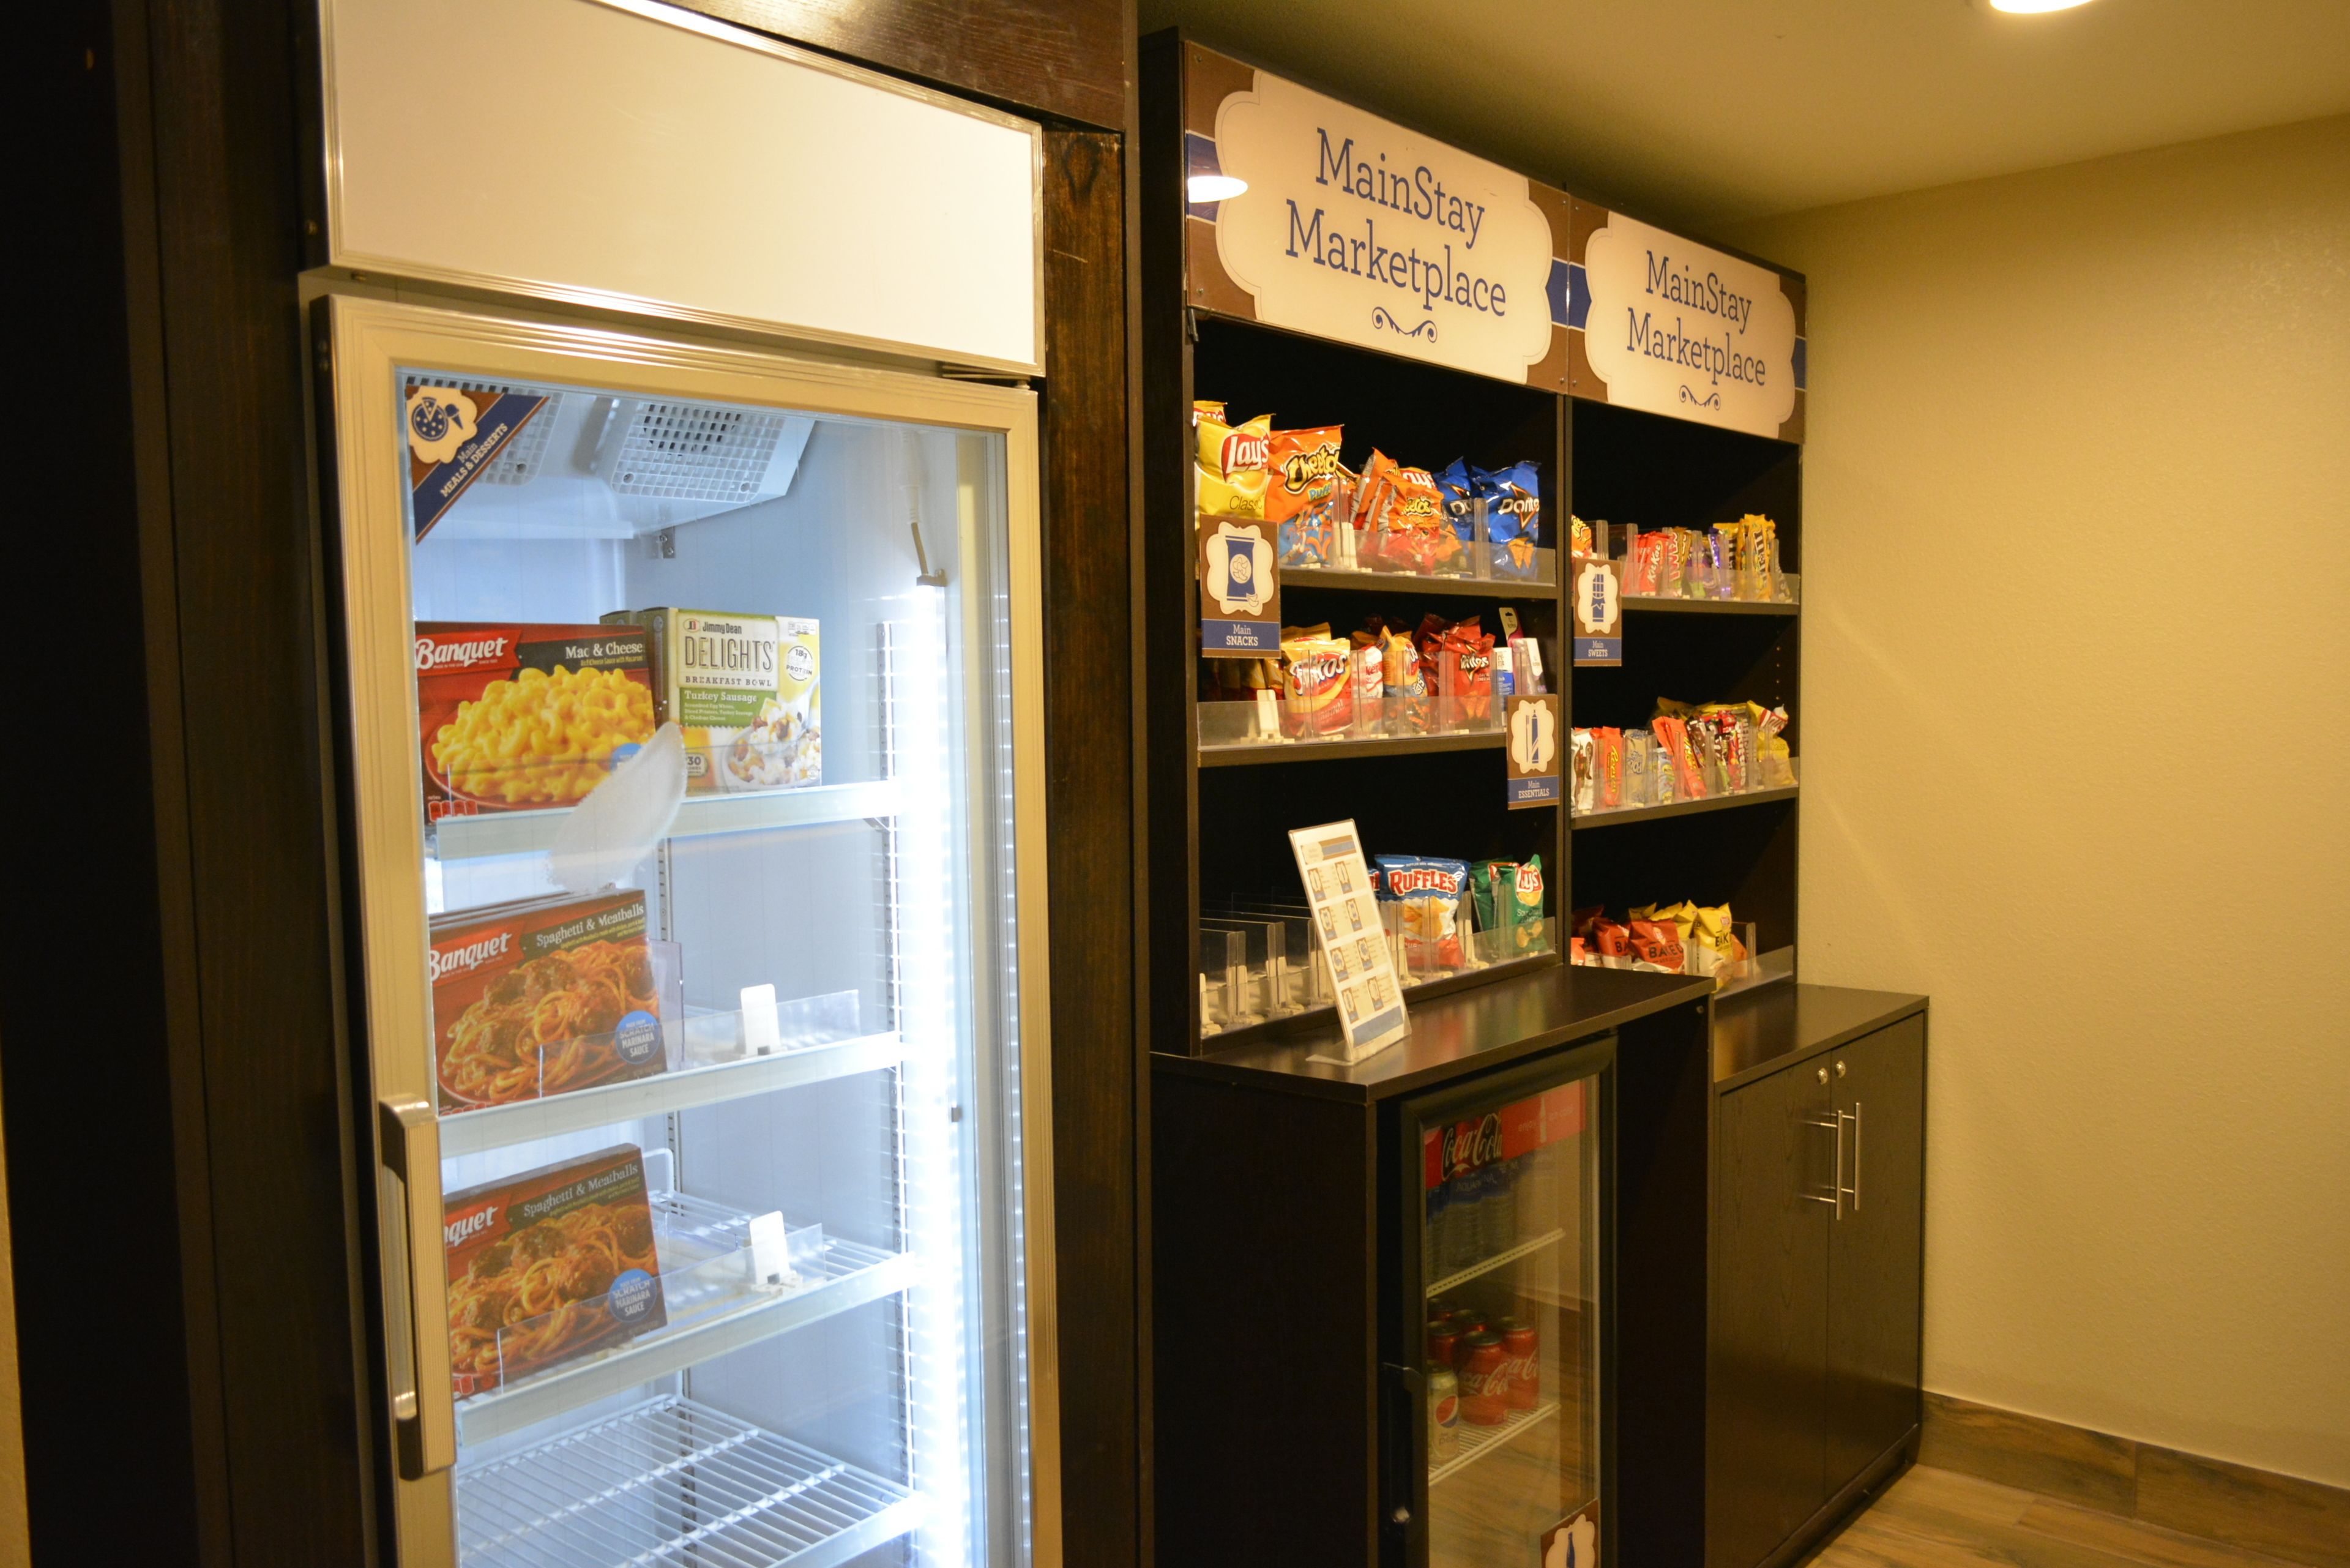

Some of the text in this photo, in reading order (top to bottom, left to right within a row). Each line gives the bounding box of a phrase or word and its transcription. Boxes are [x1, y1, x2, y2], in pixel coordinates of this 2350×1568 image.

[1315, 127, 1485, 250] MainStay
[1285, 198, 1507, 317] Marketplace
[1645, 250, 1752, 335] MainStay
[1627, 307, 1766, 386] Marketplace
[439, 467, 469, 498] MEALS
[471, 422, 509, 464] DESSERTS
[457, 442, 478, 463] Main
[1286, 444, 1341, 491] Cheeto
[703, 622, 725, 634] Jimmy
[725, 623, 742, 634] Dean
[1233, 624, 1251, 635] Main
[565, 641, 643, 659] Mac & Cheese
[1226, 635, 1259, 646] SNACKS
[1592, 640, 1604, 649] Main
[415, 637, 509, 670] Banquet
[684, 635, 772, 671] DELIGHTS
[1587, 649, 1608, 658] SWEETS
[685, 675, 772, 687] BREAKFAST BOWL
[684, 690, 758, 704] Turkey Sausage
[1518, 788, 1550, 799] ESSENTIALS
[1528, 780, 1540, 790] Main
[1389, 868, 1458, 896] RUFFLES
[536, 921, 584, 948] Spaghetti
[586, 917, 596, 931] &
[598, 903, 644, 927] Meatballs
[430, 932, 513, 982] Banquet
[630, 1043, 649, 1058] SAUCE
[523, 1187, 573, 1217] Spaghetti
[575, 1183, 586, 1196] &
[588, 1163, 638, 1192] Meatballs
[624, 1301, 645, 1317] SAUCE
